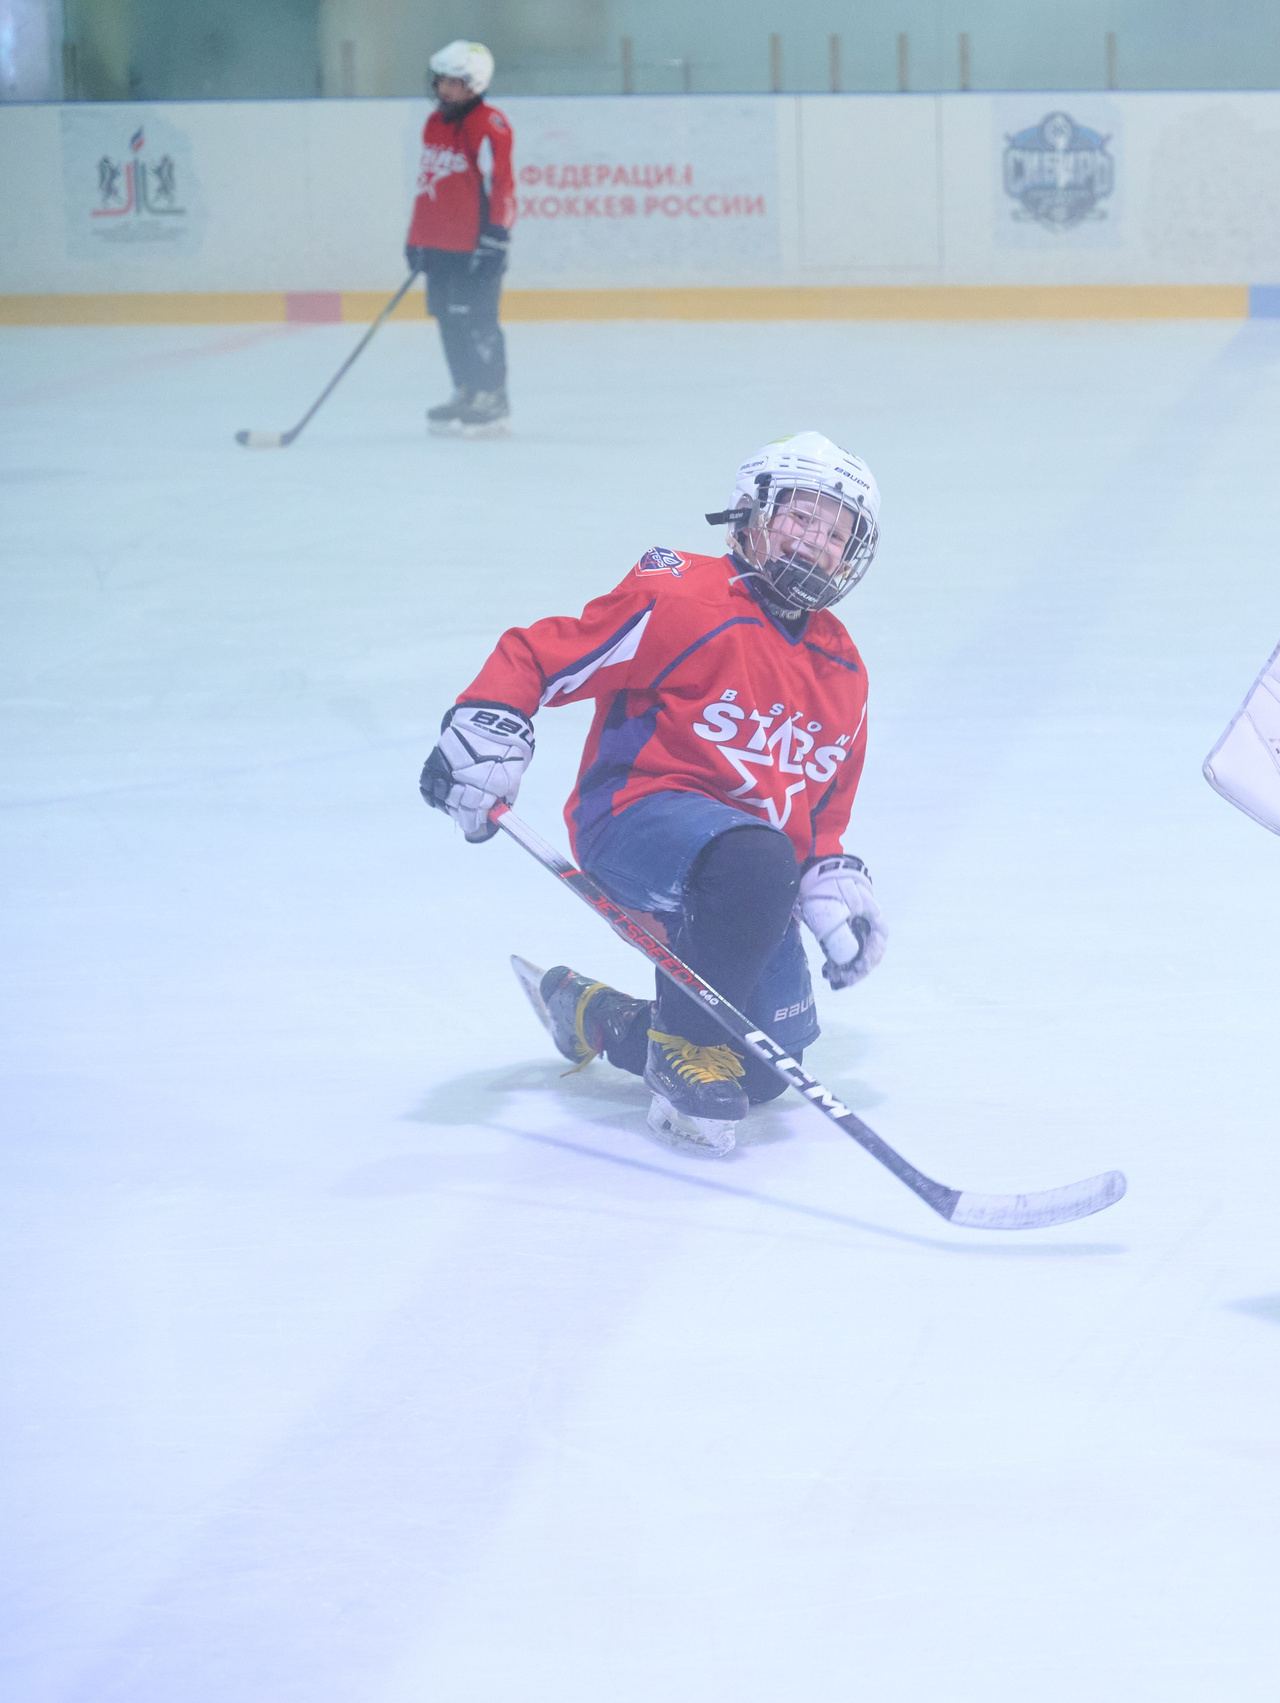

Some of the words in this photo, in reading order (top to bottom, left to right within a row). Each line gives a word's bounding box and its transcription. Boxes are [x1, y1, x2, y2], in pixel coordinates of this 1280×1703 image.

[519, 195, 636, 219] ХОККЕЯ
[643, 195, 767, 218] РОССИИ
[469, 710, 535, 750] BAU
[719, 688, 851, 747] BSTON
[584, 894, 693, 984] JETSPEED
[744, 1029, 852, 1119] CCM
